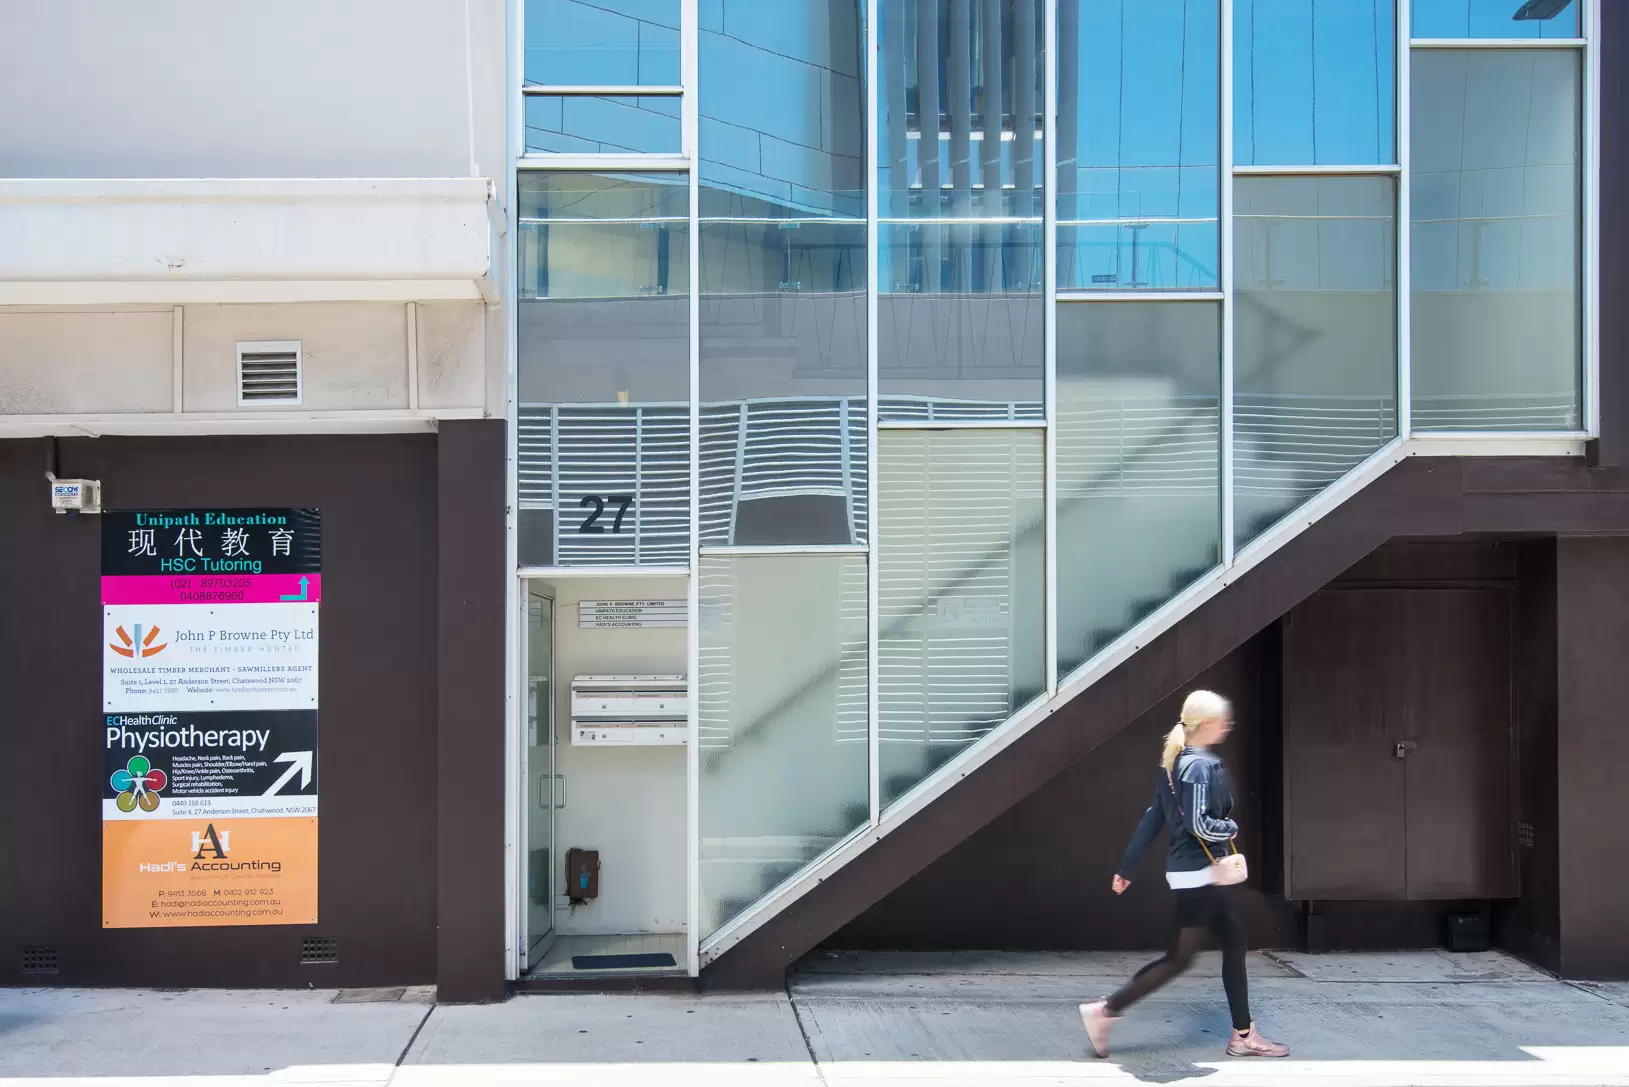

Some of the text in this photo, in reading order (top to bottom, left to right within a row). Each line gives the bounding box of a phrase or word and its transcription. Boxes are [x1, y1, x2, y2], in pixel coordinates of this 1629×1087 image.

[136, 513, 287, 528] Unipath Education
[578, 495, 632, 534] 27
[128, 528, 294, 556] 现代教育
[160, 558, 261, 574] HSC Tutoring
[171, 579, 251, 590] (02) 89703205
[180, 591, 244, 600] 0408876960
[175, 629, 313, 642] John P Browne Pty Ltd
[107, 724, 270, 753] Physiotherapy
[191, 860, 281, 872] Accounting
[161, 899, 281, 908] hadi@hadiaccounting.com.au
[163, 909, 283, 917] www.hadiaccounting.com.au
